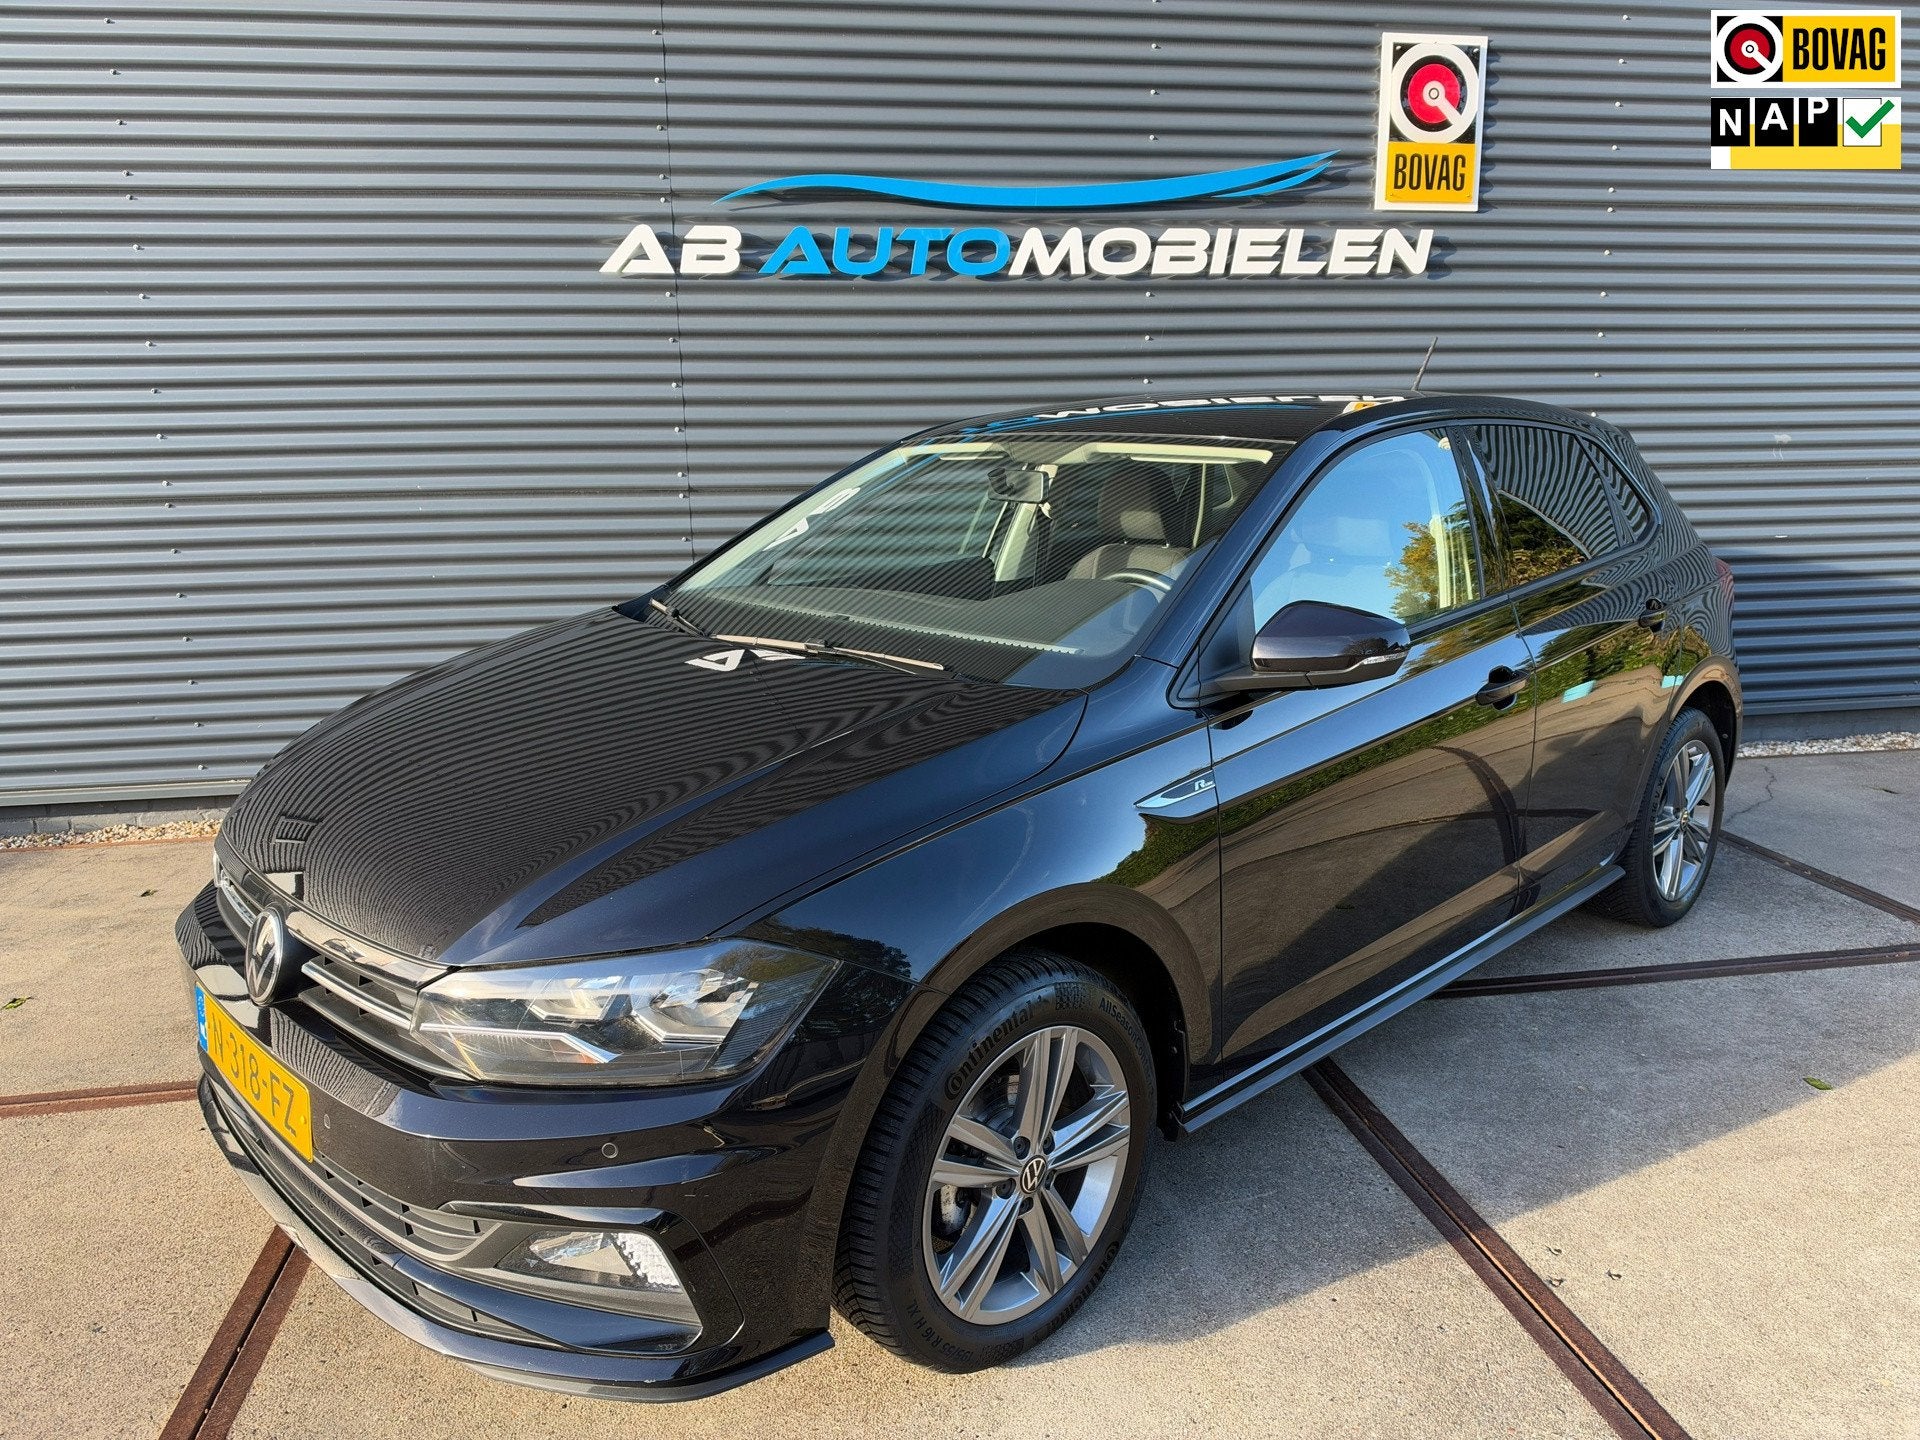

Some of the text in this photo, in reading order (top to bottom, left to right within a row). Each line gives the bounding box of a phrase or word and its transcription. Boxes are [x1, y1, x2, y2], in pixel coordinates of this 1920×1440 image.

[1393, 152, 1466, 192] BOVAG
[600, 224, 1434, 277] AB AUTOMOBIELEN
[212, 1012, 297, 1138] N-318-FZ
[944, 1000, 1036, 1100] Continental
